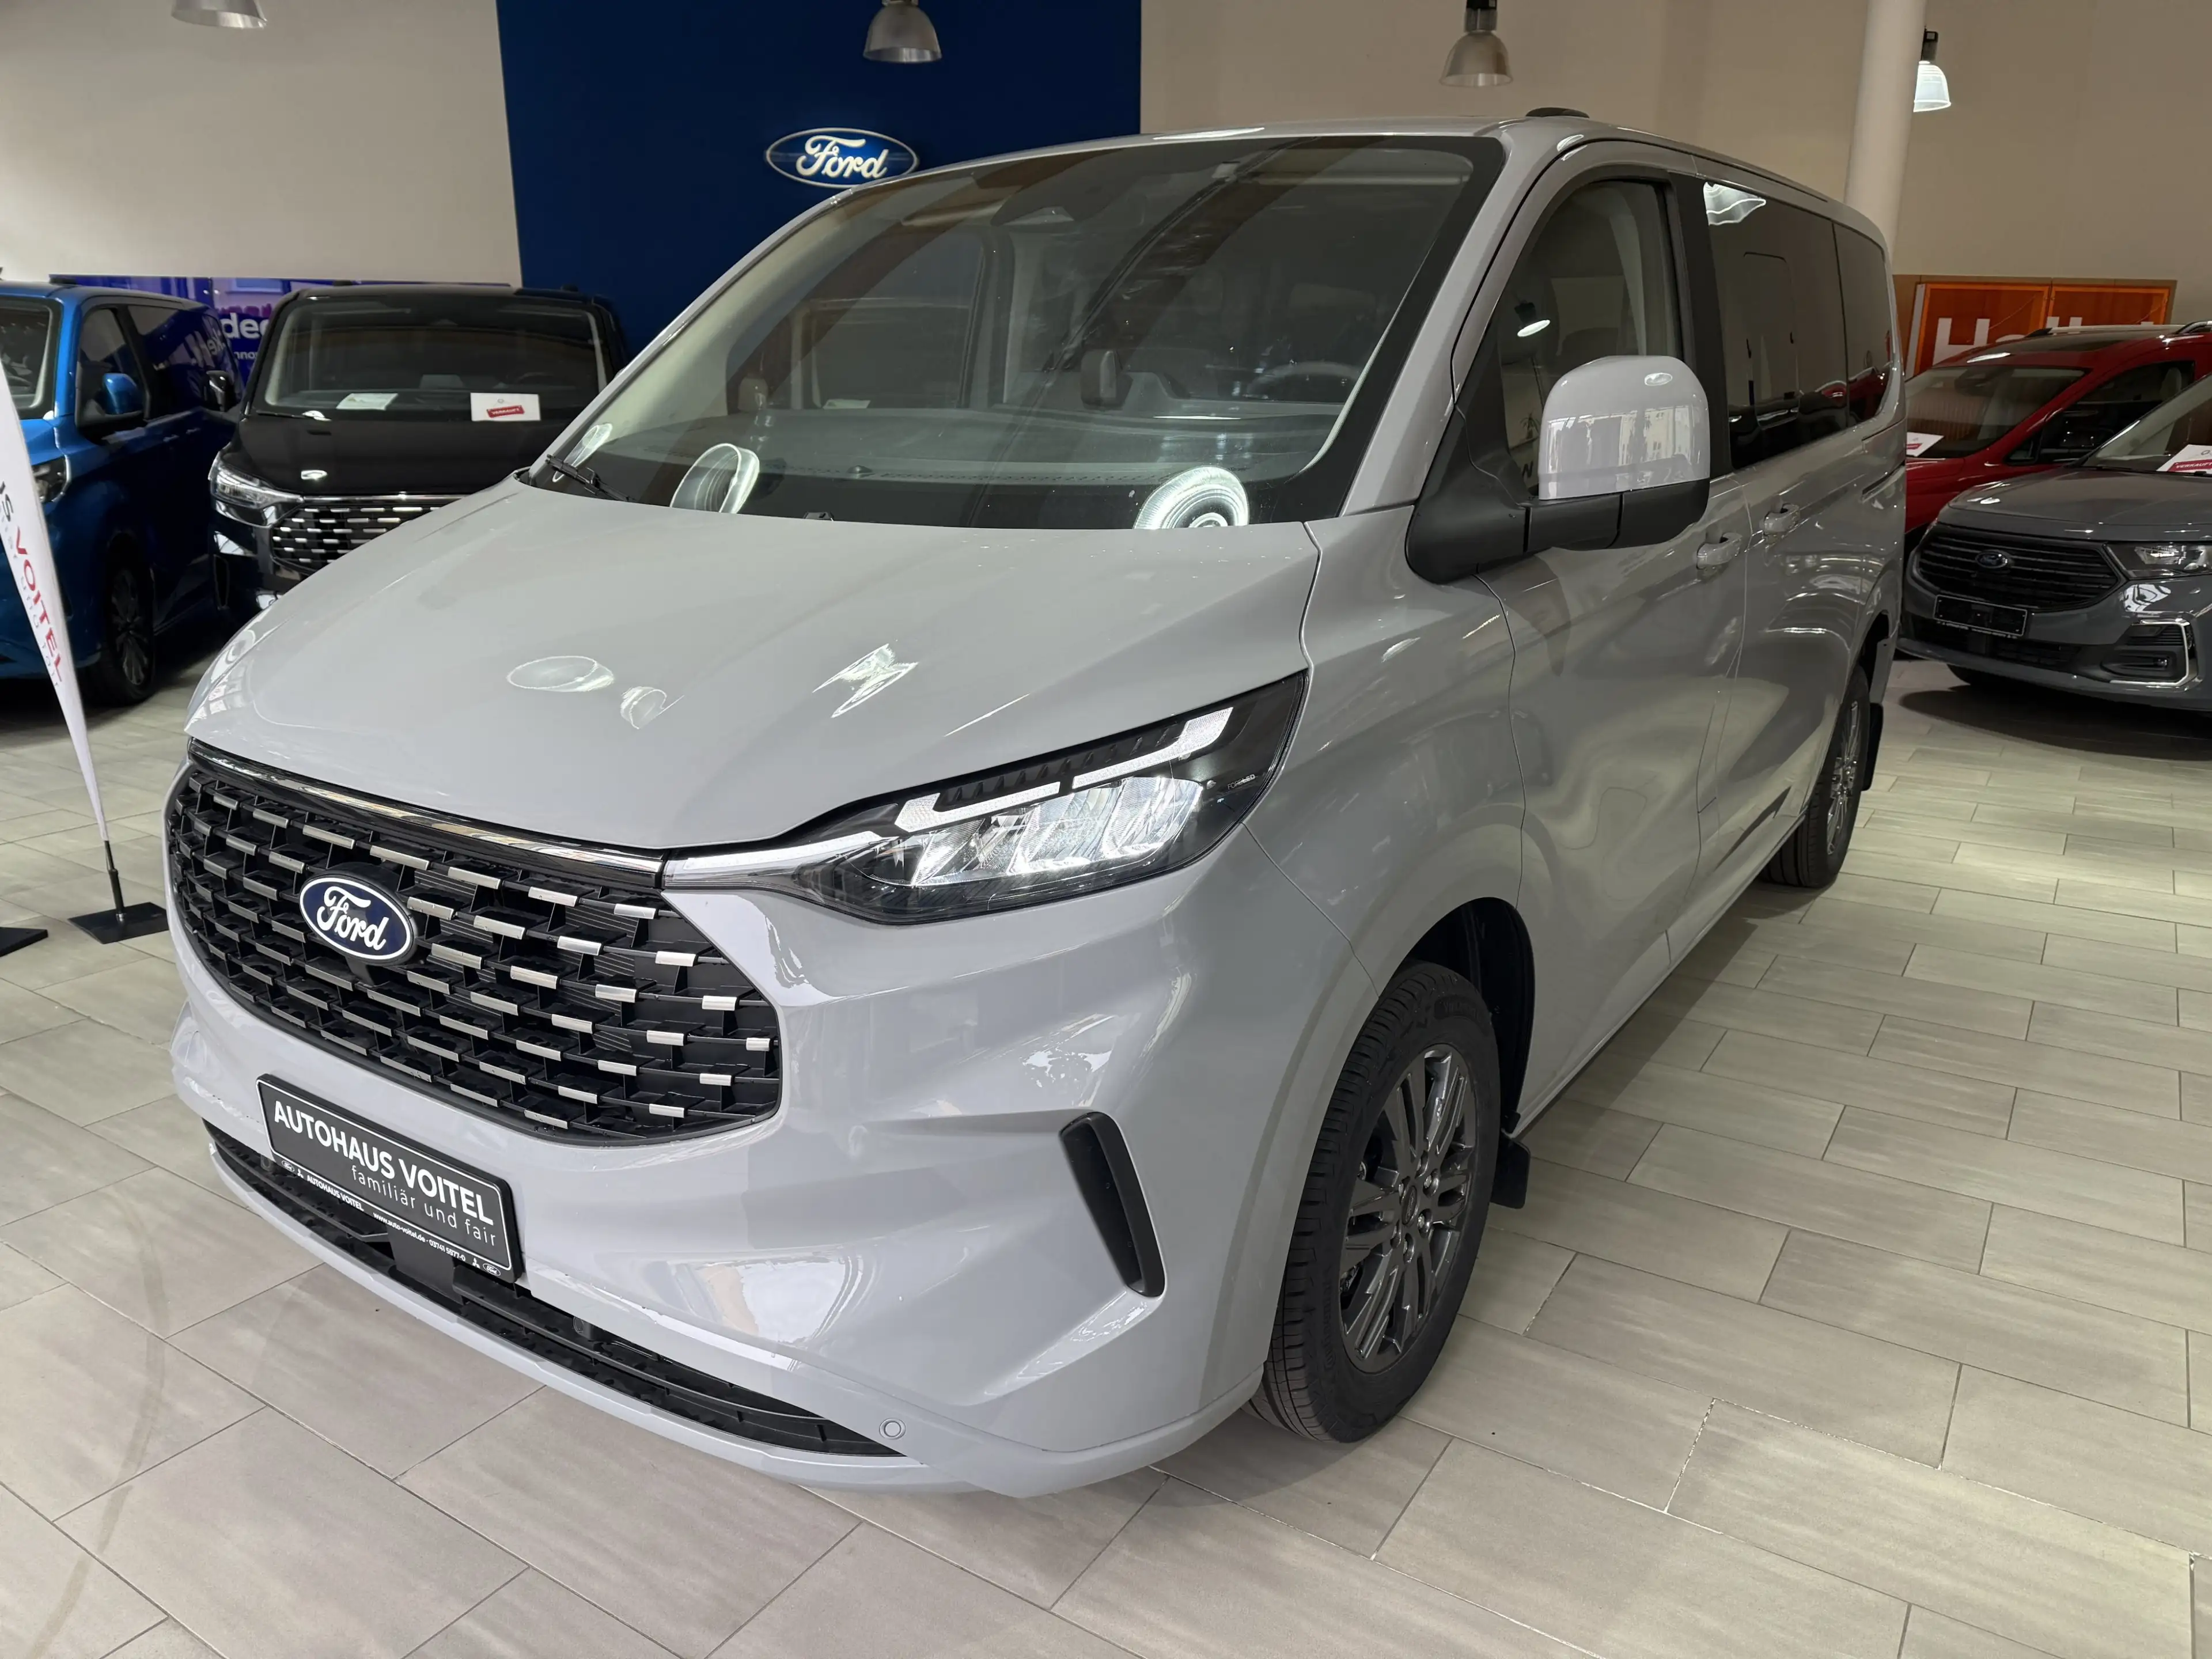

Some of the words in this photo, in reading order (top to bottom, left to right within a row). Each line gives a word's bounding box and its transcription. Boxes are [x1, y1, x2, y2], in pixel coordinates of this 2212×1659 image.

[796, 135, 889, 179] Ford
[16, 525, 63, 683] VOITEL
[317, 886, 389, 950] Ford
[274, 1100, 395, 1179] AUTOHAUS
[398, 1158, 494, 1226] VOITEL
[306, 1175, 340, 1199] AUTOHAUS
[340, 1194, 364, 1212] VOITEL
[373, 1212, 426, 1243] www.auto-voitel.de
[351, 1165, 416, 1209] familiär
[424, 1203, 457, 1229] und
[464, 1218, 496, 1246] fair
